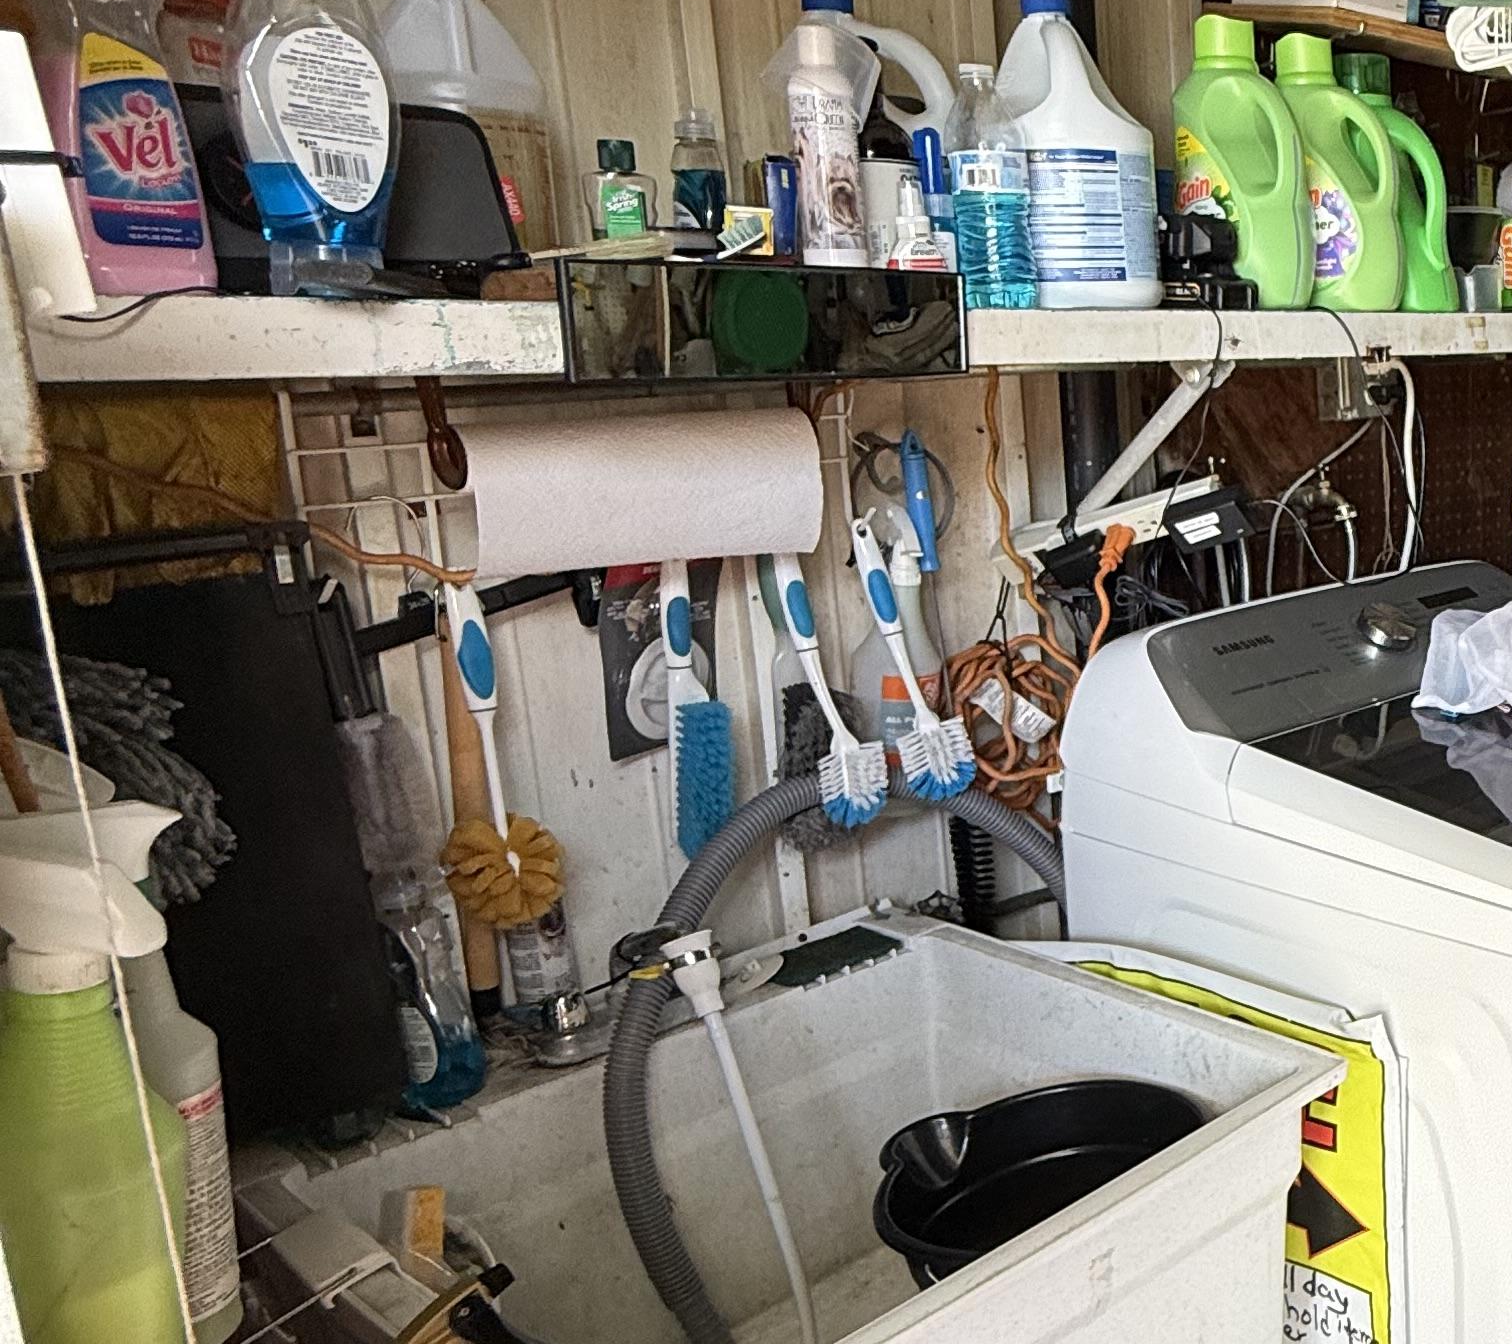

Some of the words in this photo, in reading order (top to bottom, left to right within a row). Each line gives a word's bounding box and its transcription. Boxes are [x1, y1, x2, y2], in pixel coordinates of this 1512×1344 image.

[95, 116, 177, 173] Vel
[606, 198, 639, 212] Spring
[1178, 177, 1211, 208] Gain
[1213, 635, 1275, 656] SAMSUNG
[1303, 1269, 1348, 1315] day
